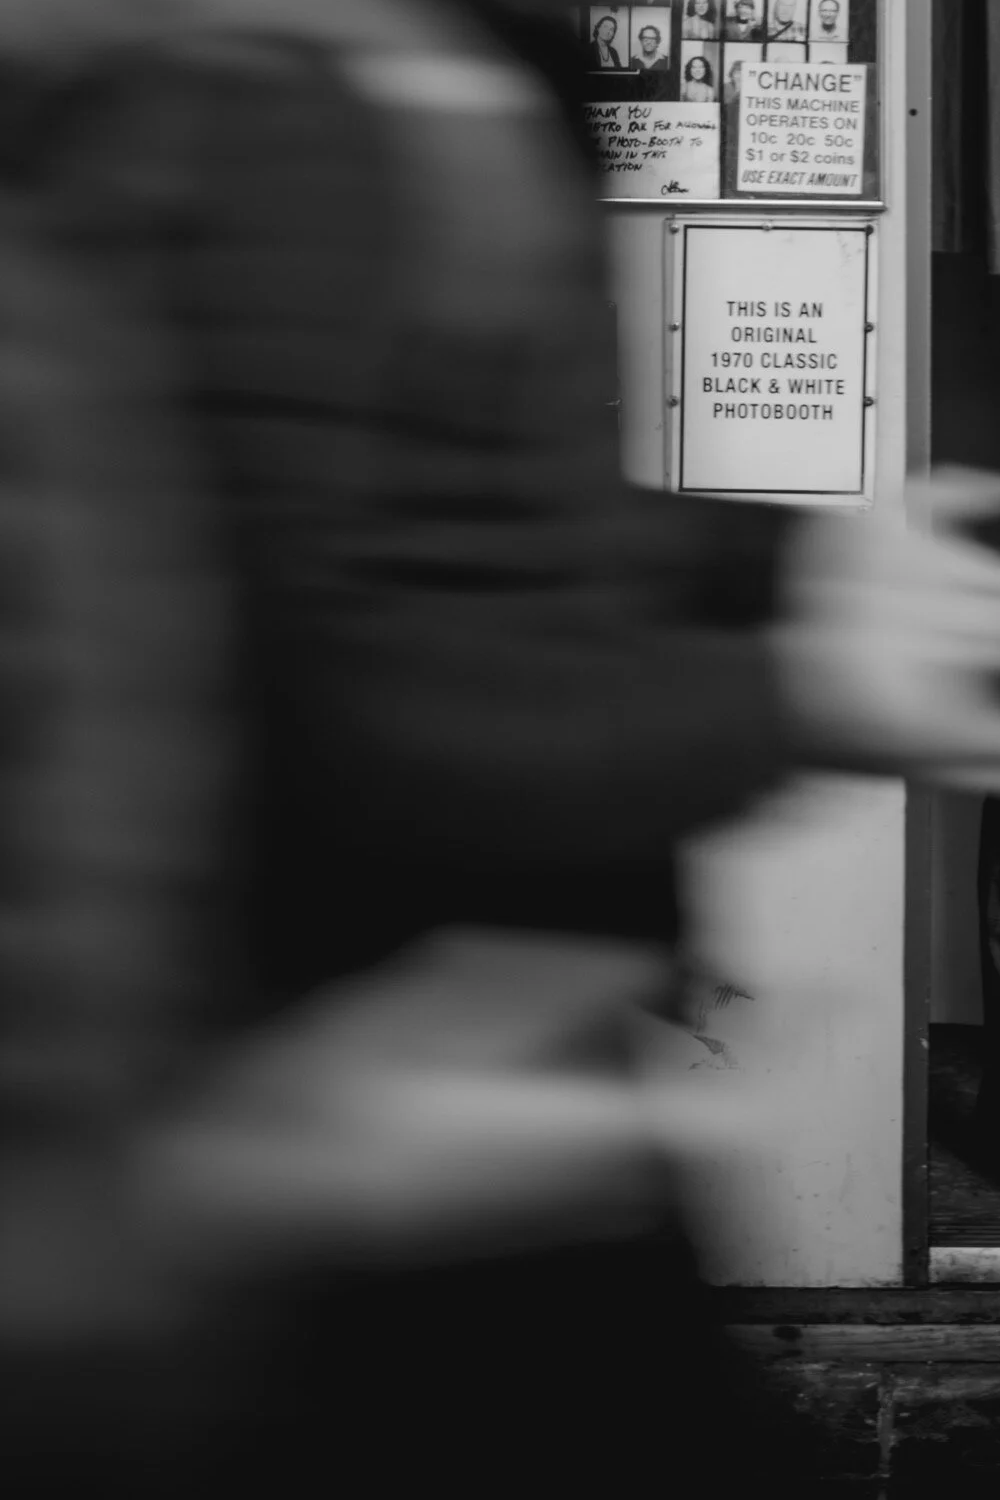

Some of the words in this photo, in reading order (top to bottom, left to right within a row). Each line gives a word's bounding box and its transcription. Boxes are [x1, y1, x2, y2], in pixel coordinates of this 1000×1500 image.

[628, 105, 652, 119] YOU
[745, 95, 781, 110] THIS
[786, 98, 861, 113] MACHINE
[590, 122, 622, 133] ETRO
[653, 120, 671, 133] FOR
[746, 113, 829, 130] OPERATES
[833, 117, 858, 130] ON
[689, 136, 704, 147] TO
[750, 131, 778, 144] 10c
[786, 132, 815, 146] 20c
[823, 134, 853, 148] 50c
[745, 148, 764, 161] $1
[769, 152, 786, 162] or
[789, 150, 809, 163] $2
[814, 151, 855, 165] coins
[741, 169, 767, 184] USE
[767, 170, 806, 185] EXACT
[806, 172, 859, 187] AMOUNT
[726, 301, 767, 317] THIS
[774, 301, 791, 318] IS
[798, 302, 823, 318] AN
[731, 326, 818, 343] ORIGINAL
[710, 351, 753, 368] 1970
[760, 352, 838, 369] CLASSIC
[702, 377, 762, 393] BLACK
[767, 378, 780, 394] &
[788, 378, 846, 395] WHITE
[712, 402, 834, 420] PHOTOBOOTH
